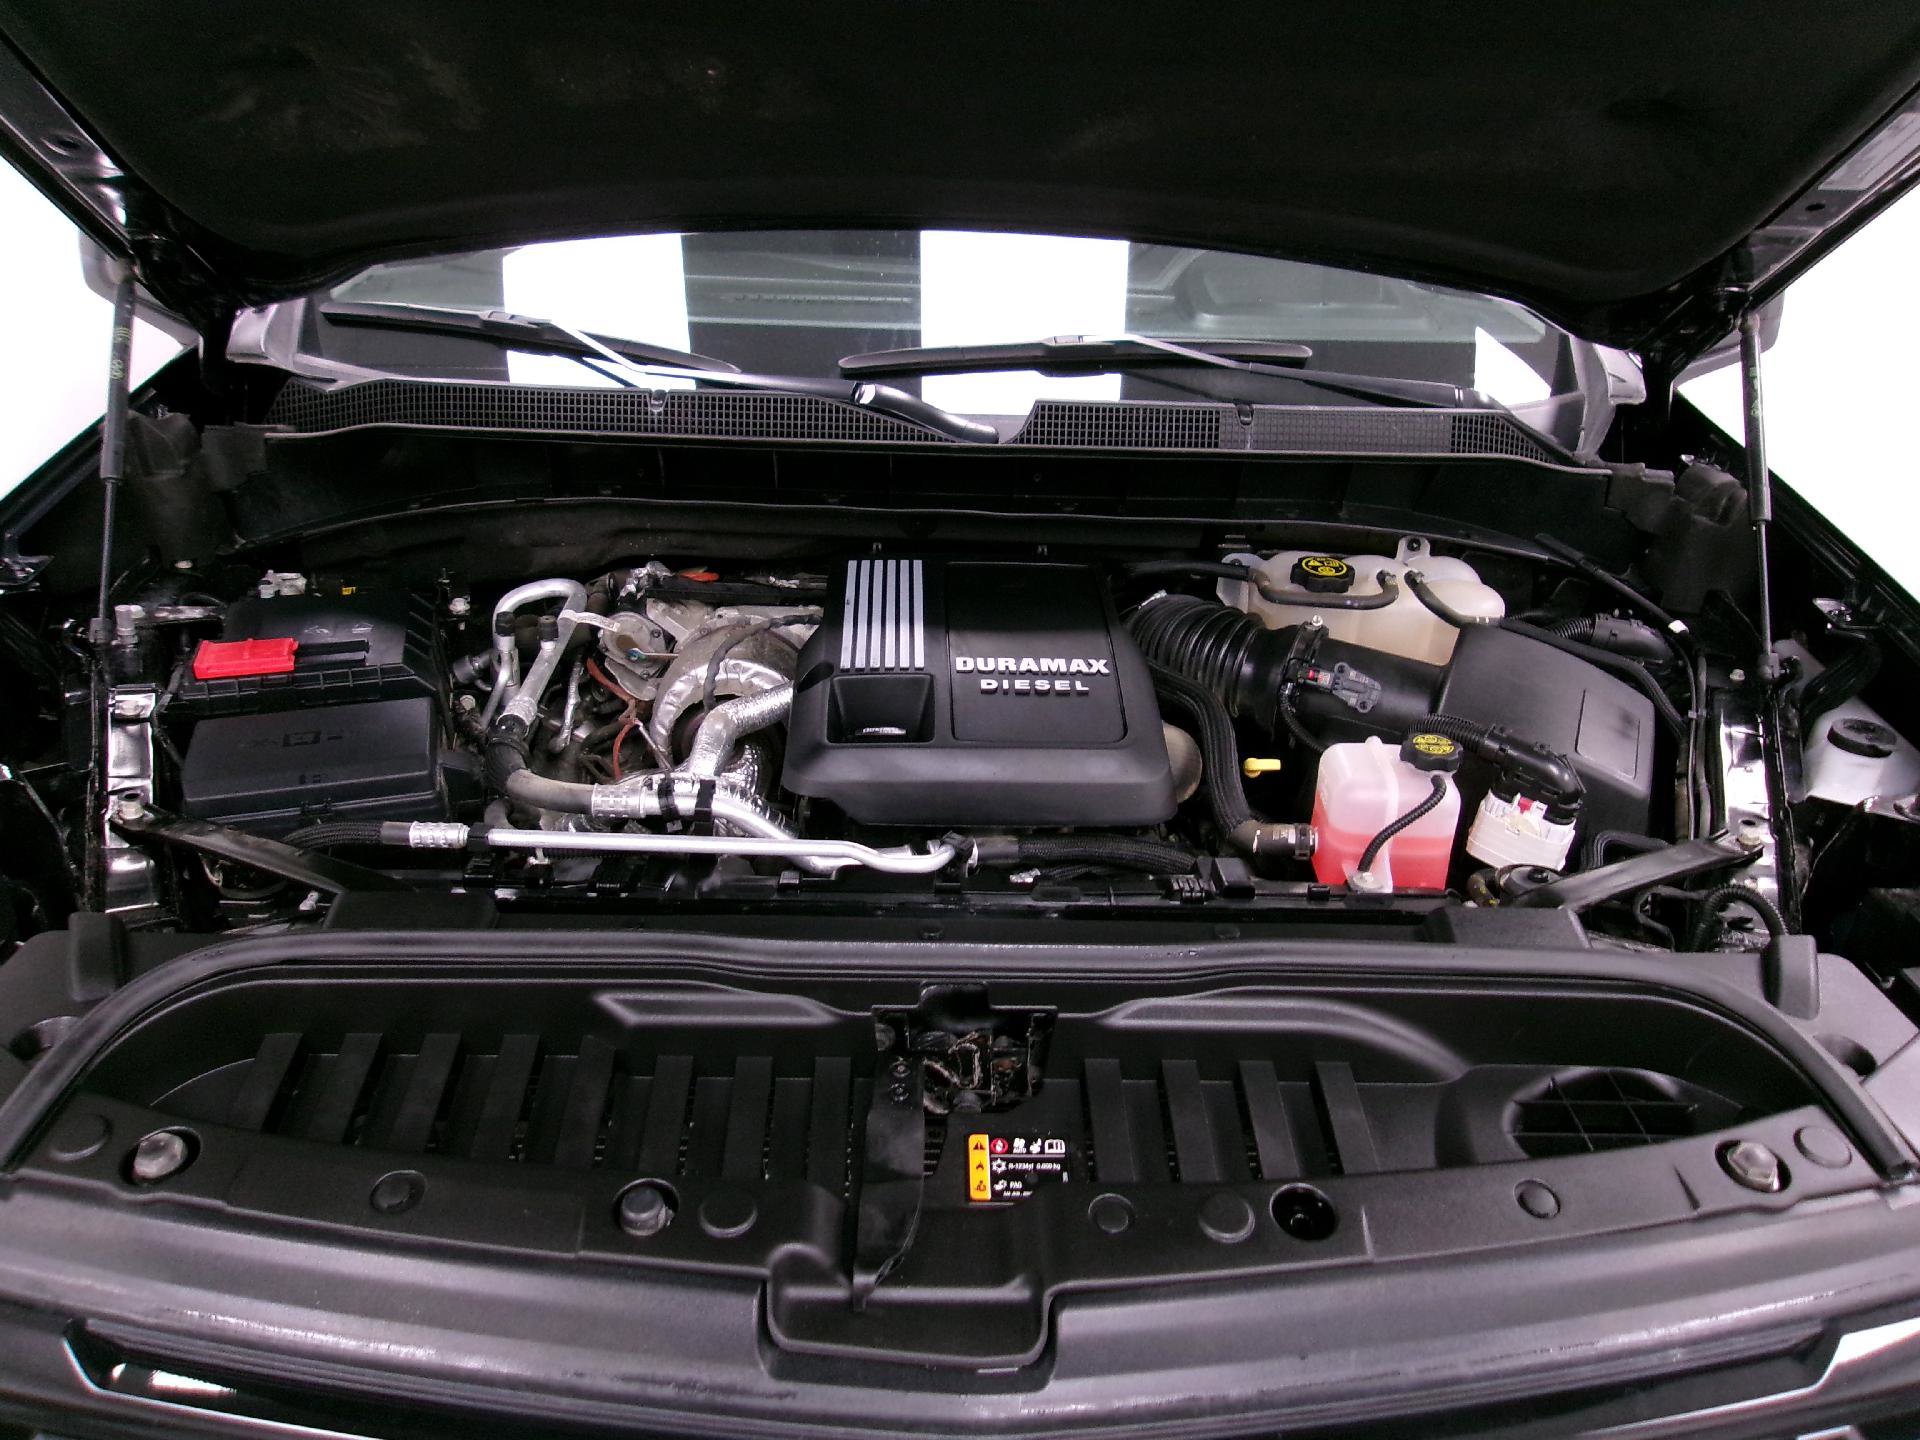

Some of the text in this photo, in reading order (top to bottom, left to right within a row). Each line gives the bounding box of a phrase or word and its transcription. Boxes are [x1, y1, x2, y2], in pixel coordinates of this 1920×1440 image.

[955, 657, 1110, 675] DURAMAX
[980, 679, 1090, 691] DIESEL
[1053, 1162, 1061, 1171] kg
